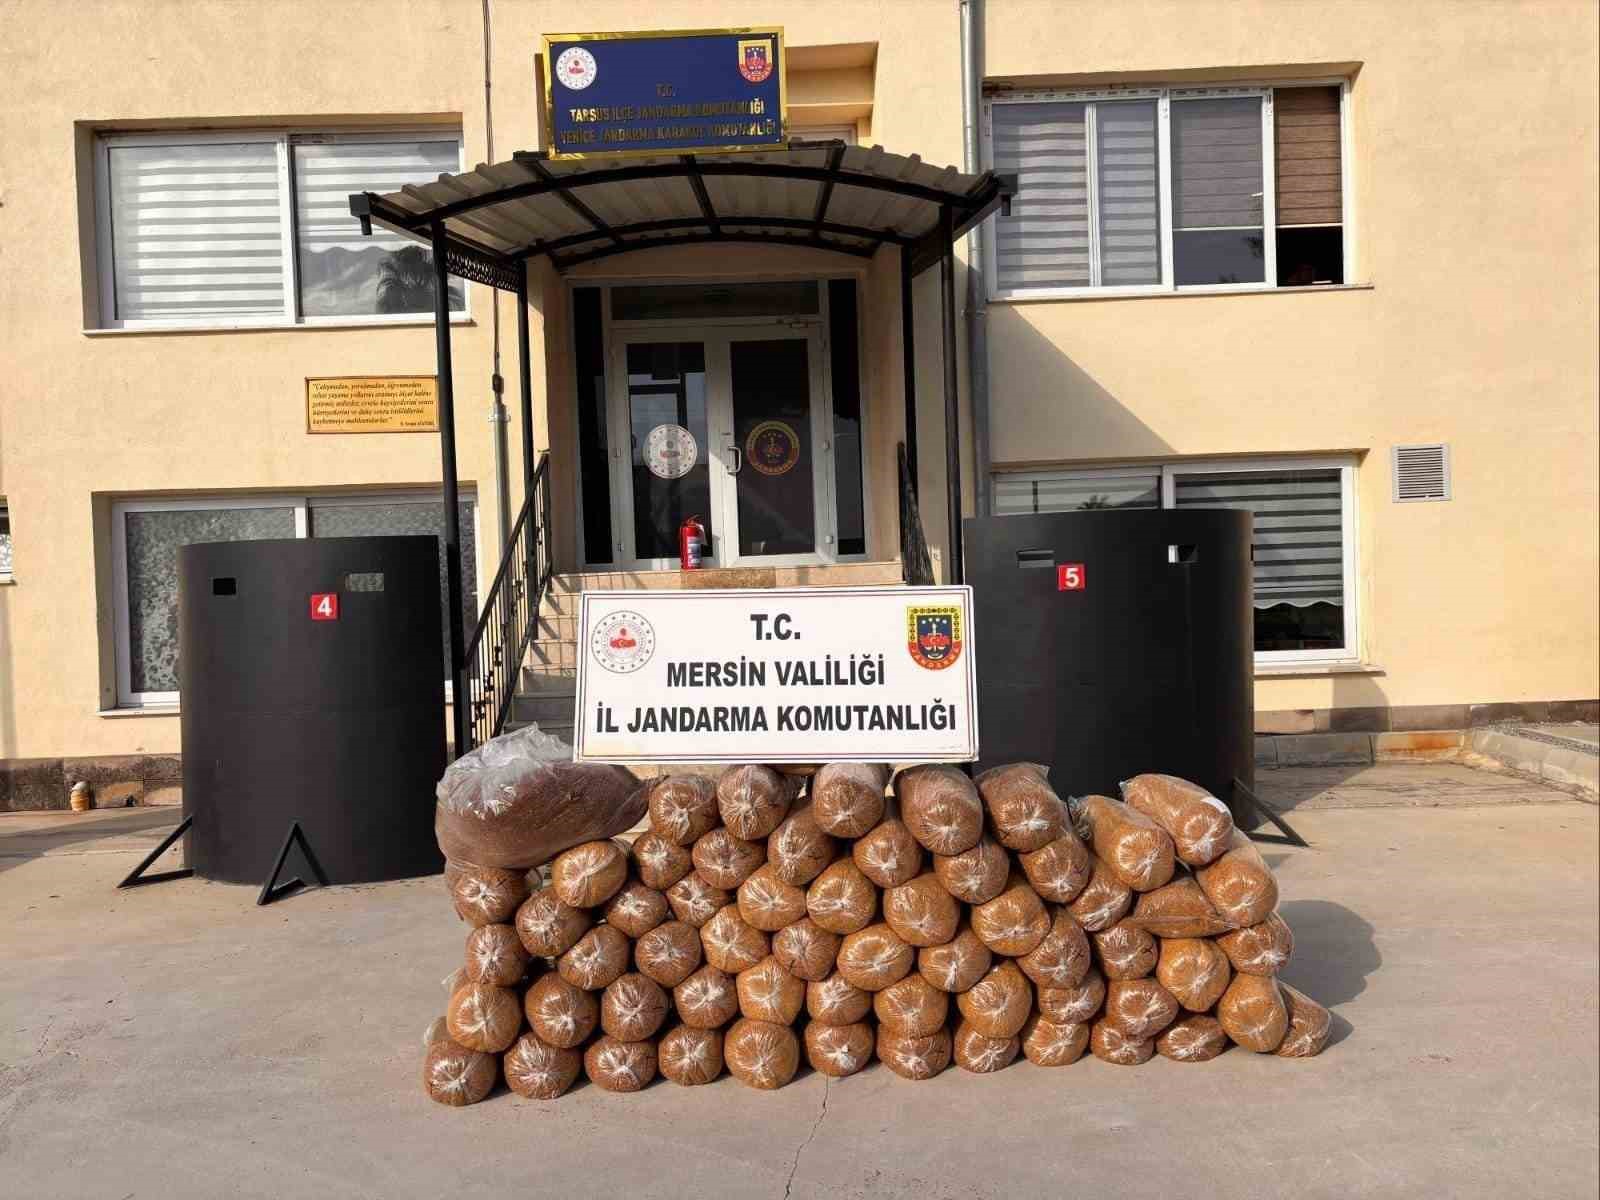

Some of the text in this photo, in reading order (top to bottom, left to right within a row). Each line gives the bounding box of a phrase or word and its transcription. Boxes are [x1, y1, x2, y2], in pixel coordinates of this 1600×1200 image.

[568, 107, 609, 122] TARSUS
[1065, 567, 1080, 587] 5
[317, 596, 332, 616] 4
[750, 613, 801, 641] T.C.
[667, 653, 885, 687] MERSİN VALİLİĞİ
[596, 698, 956, 733] İL JANDARMA KOMUTANLIĞI
